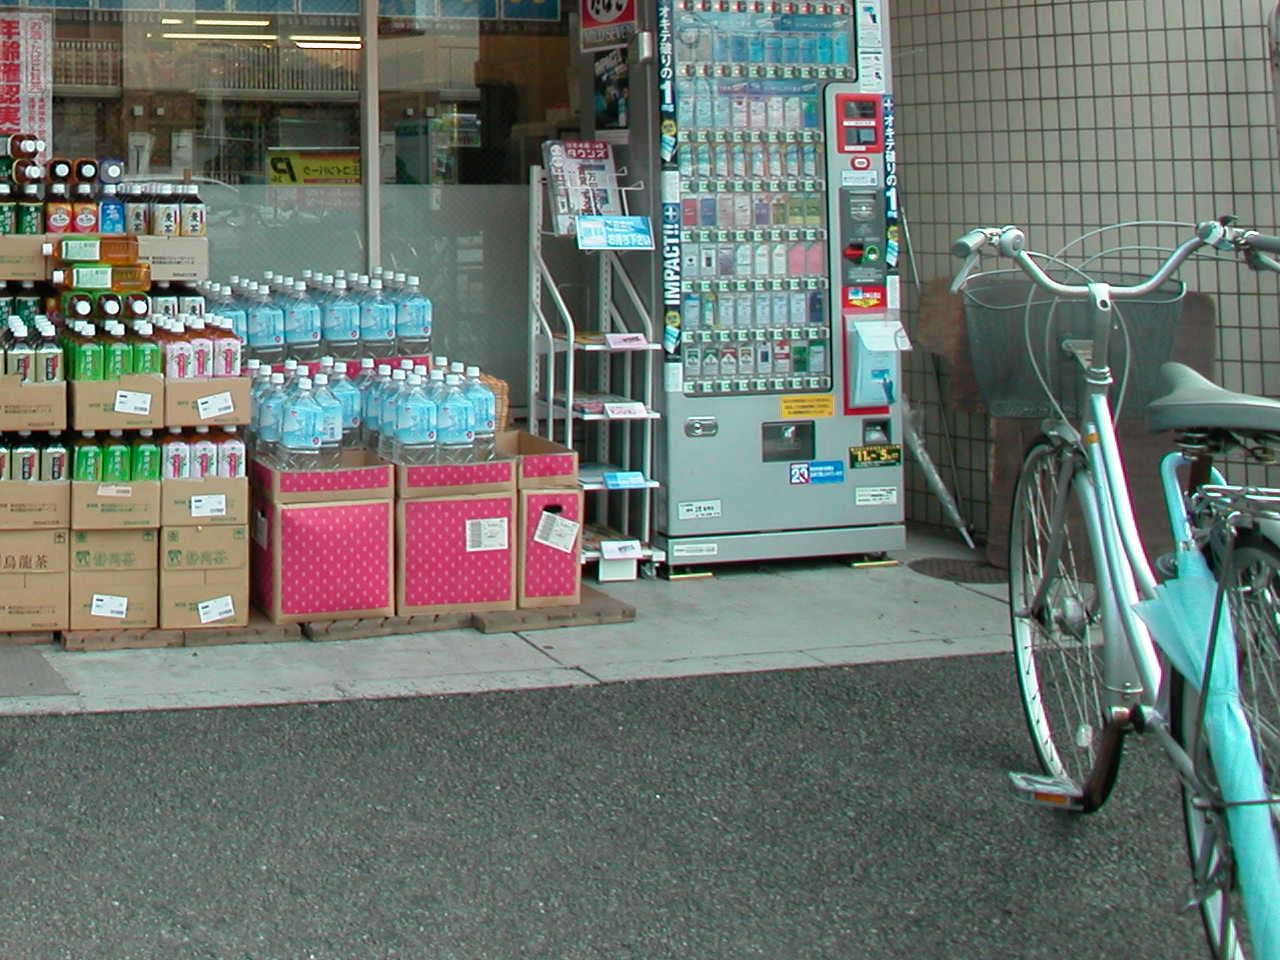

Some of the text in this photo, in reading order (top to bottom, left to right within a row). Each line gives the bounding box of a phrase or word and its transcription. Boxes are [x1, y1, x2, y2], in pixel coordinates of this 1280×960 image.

[663, 223, 681, 305] IMPACT!!
[3, 553, 49, 569] 烏龍茶
